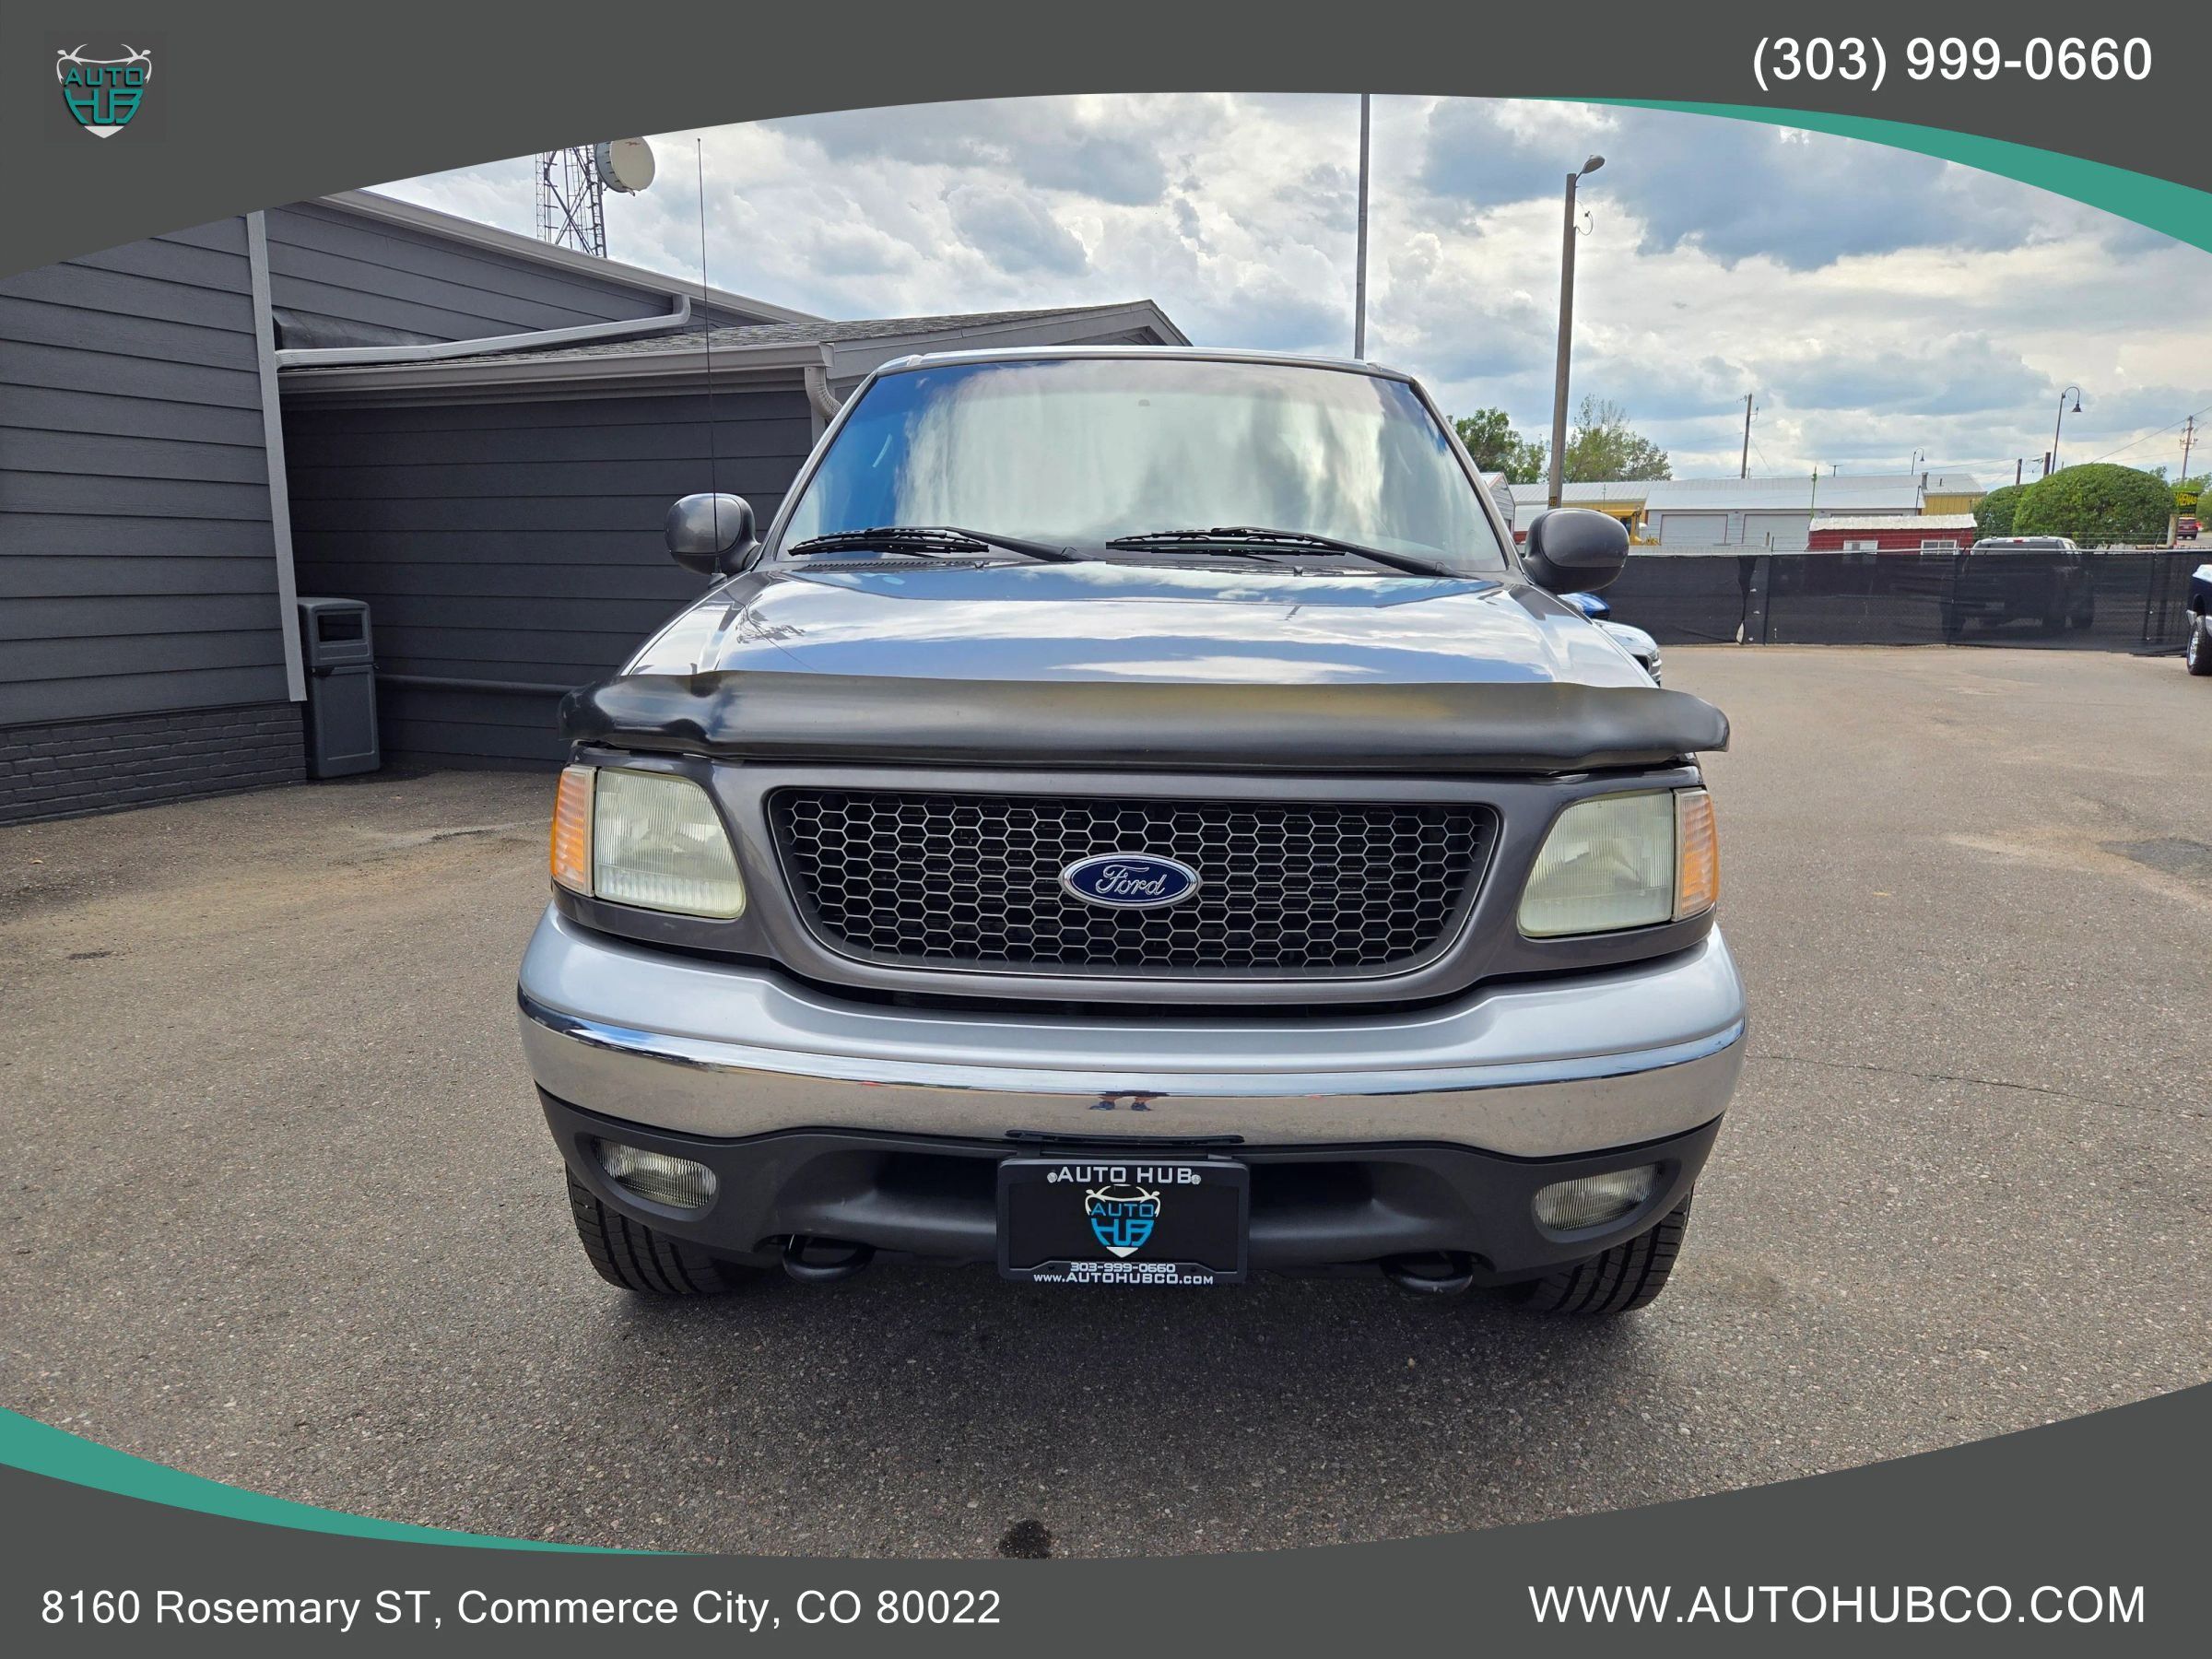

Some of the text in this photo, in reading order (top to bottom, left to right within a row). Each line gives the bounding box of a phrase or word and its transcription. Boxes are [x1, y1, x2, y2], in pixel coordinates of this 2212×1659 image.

[1095, 864, 1168, 896] Ford
[1056, 1166, 1193, 1184] AUTO HUB
[1090, 1202, 1154, 1218] AUTO
[1090, 1218, 1155, 1247] HUB
[1070, 1263, 1176, 1274] 303-999-0660
